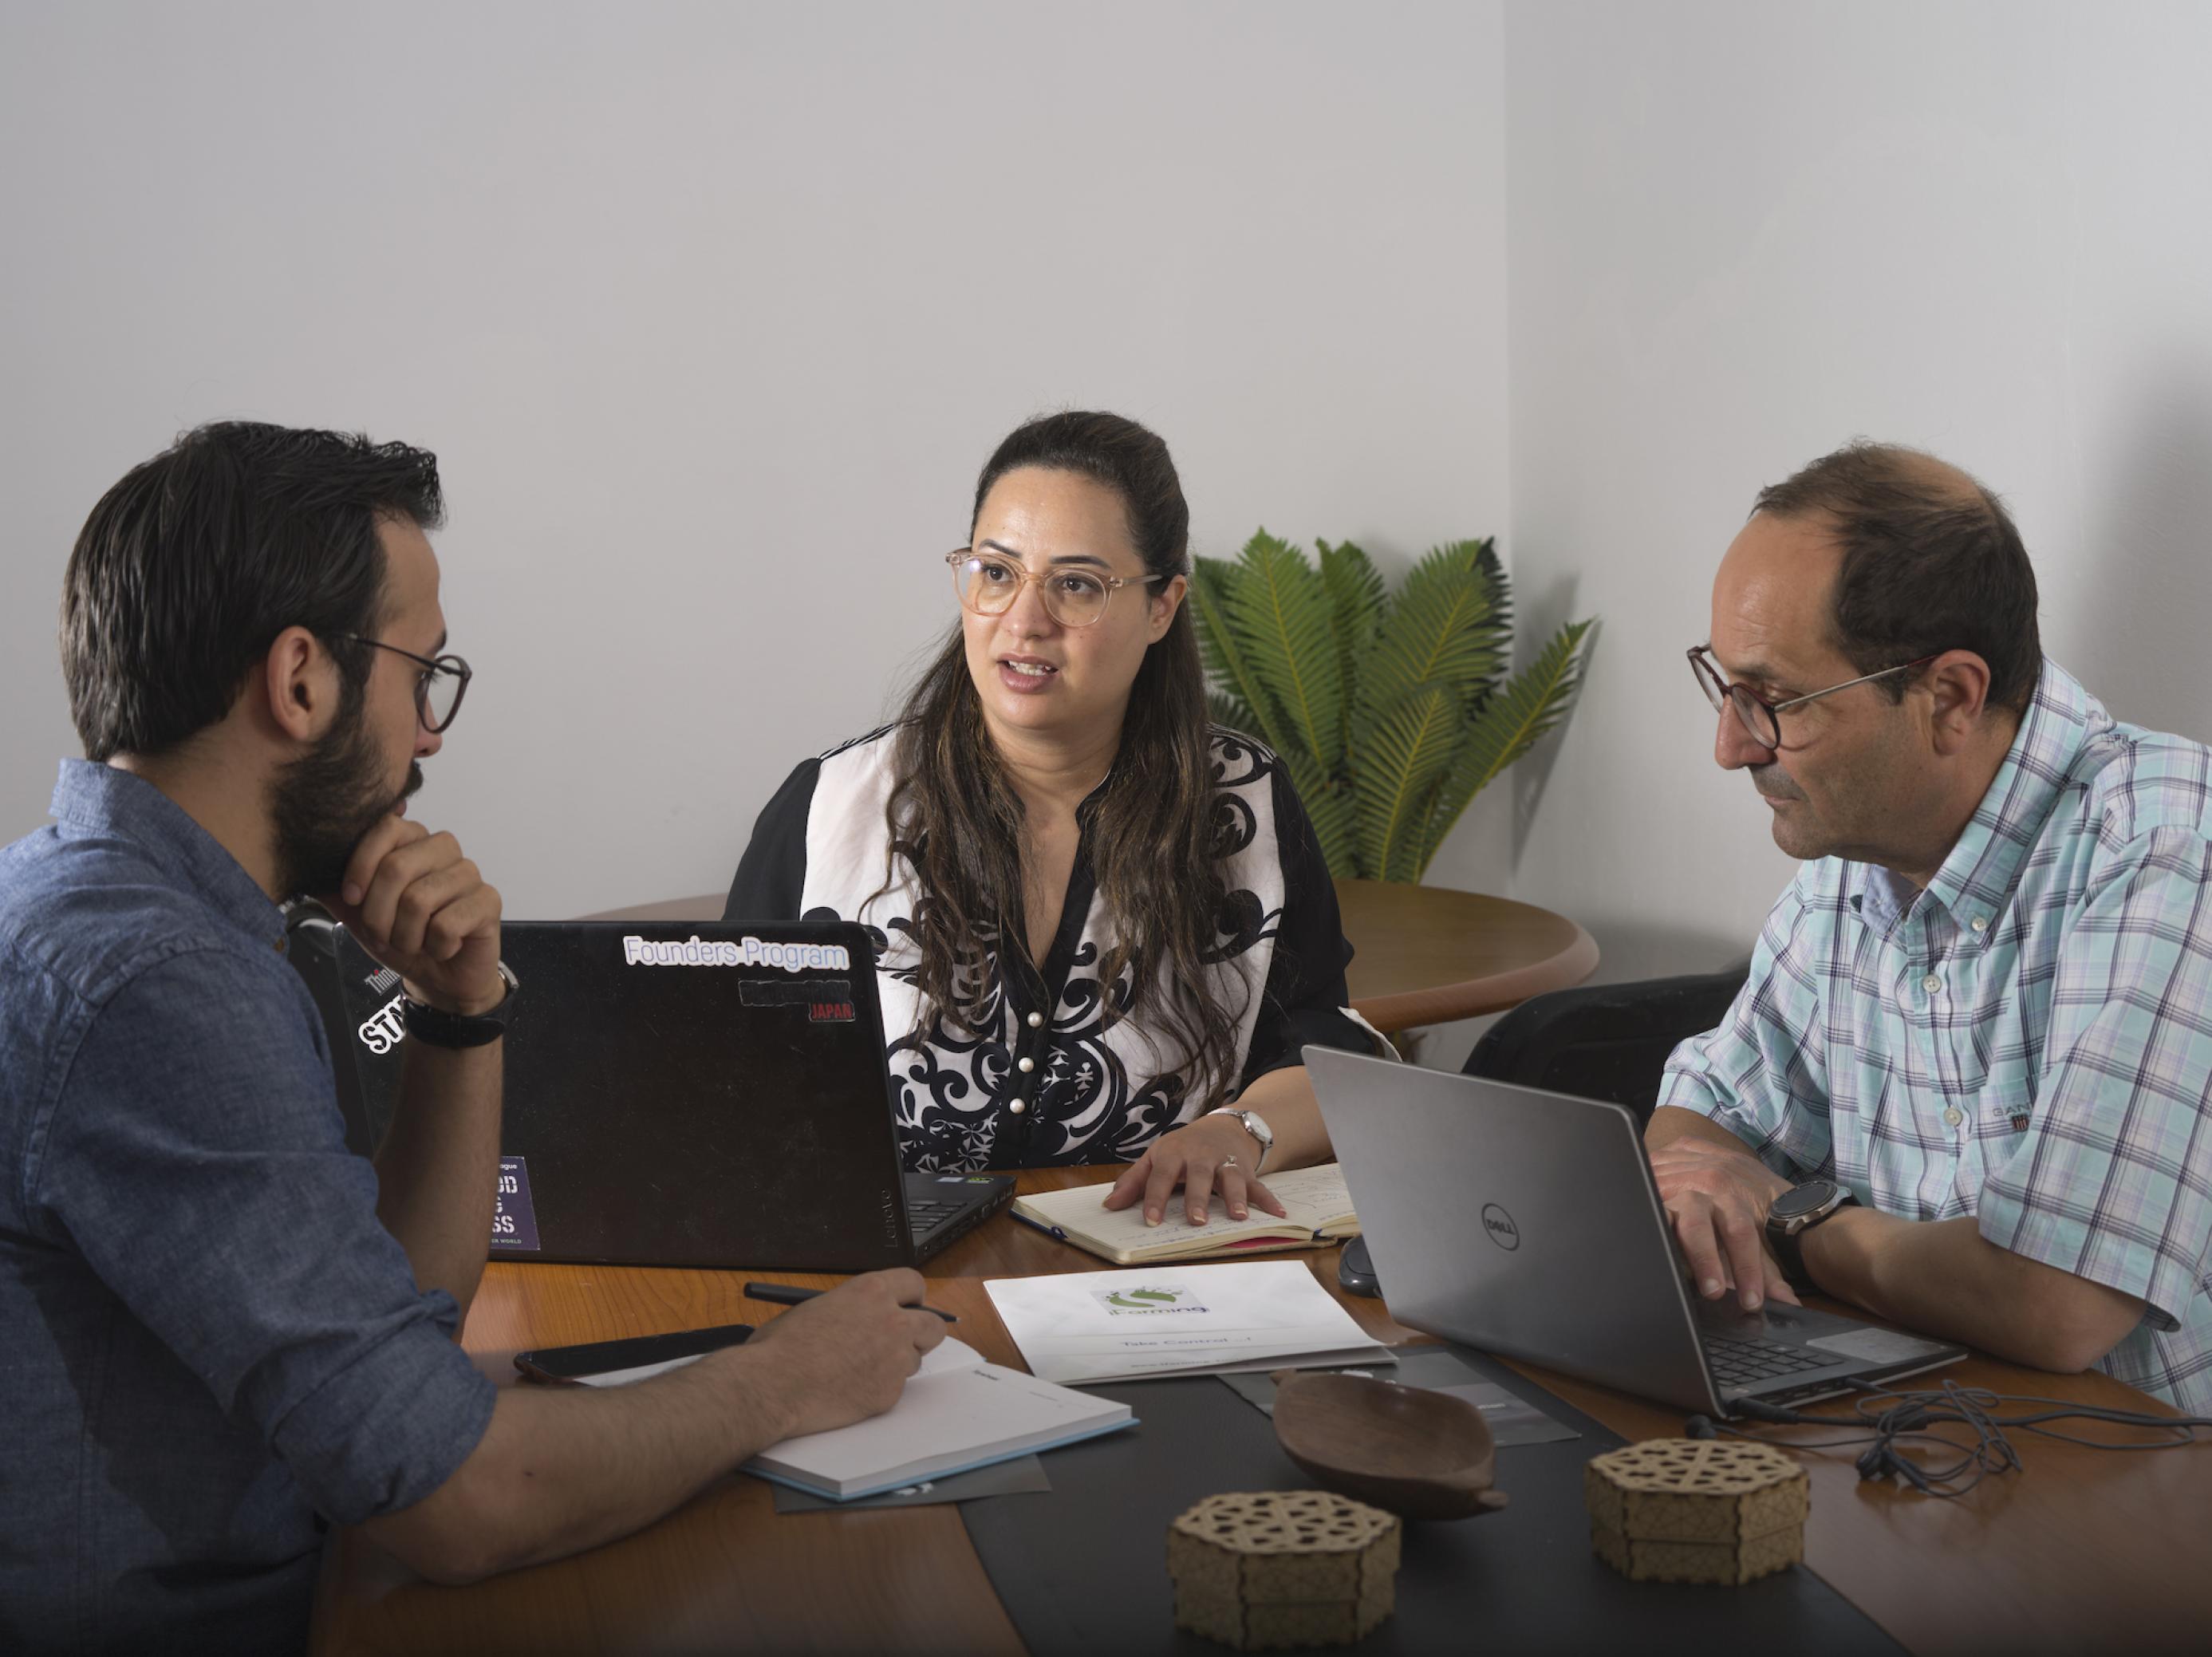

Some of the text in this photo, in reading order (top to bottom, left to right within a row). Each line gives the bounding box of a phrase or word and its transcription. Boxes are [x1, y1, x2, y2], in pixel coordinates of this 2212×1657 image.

[625, 939, 846, 969] Founders Program
[364, 965, 401, 996] Think
[812, 1004, 852, 1019] JAPAN
[1993, 1103, 2031, 1117] GAN
[492, 1215, 515, 1234] SS
[881, 1188, 898, 1249] Lenovo
[1486, 1218, 1516, 1236] DELL
